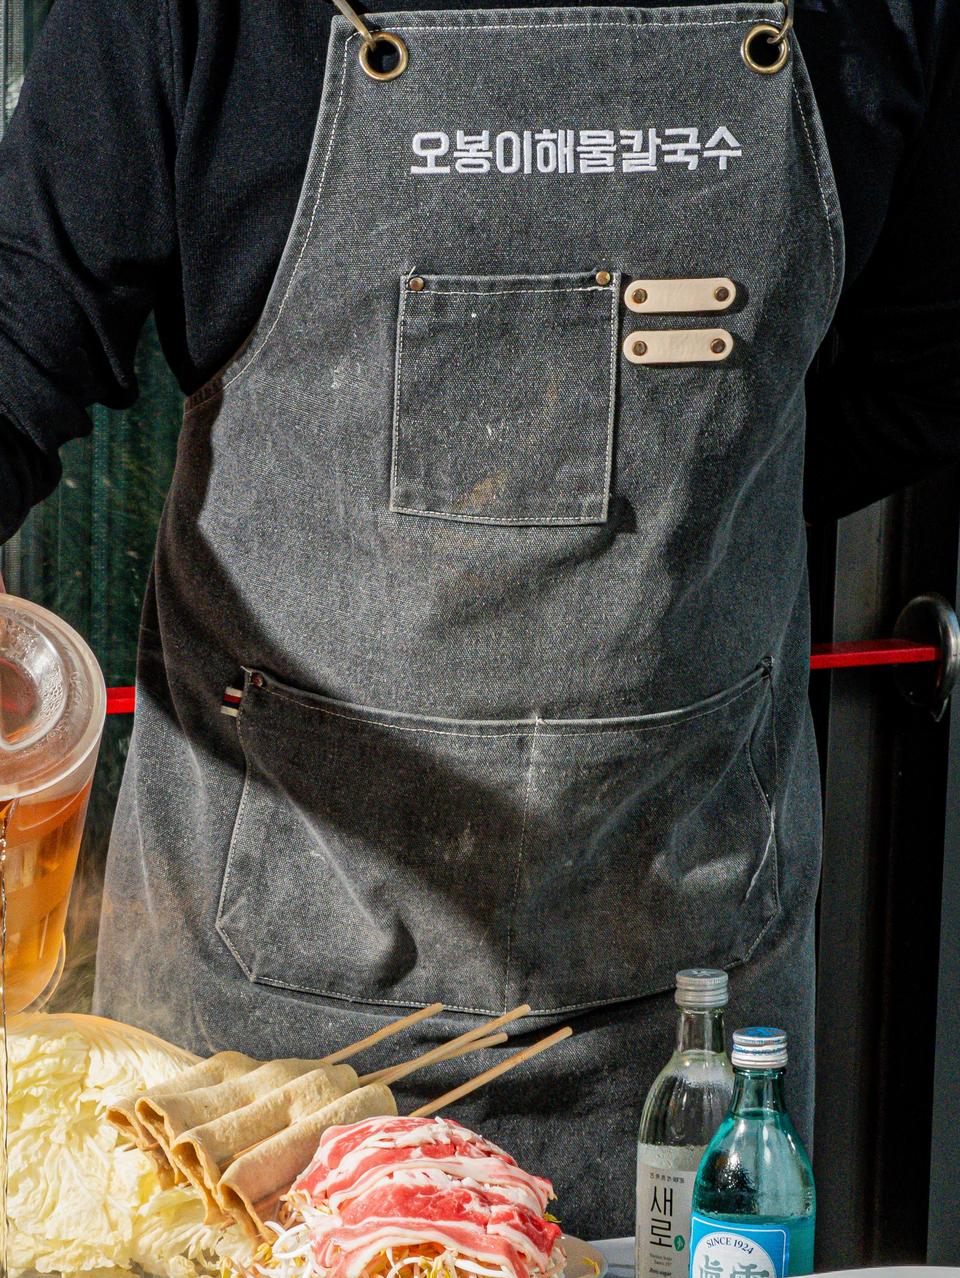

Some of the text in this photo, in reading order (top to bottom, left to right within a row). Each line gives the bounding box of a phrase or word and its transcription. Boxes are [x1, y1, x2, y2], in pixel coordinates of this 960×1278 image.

[410, 126, 742, 175] 오봉이해물칼국수
[649, 1186, 673, 1248] 새로
[706, 1236, 754, 1255] SINCE 1924
